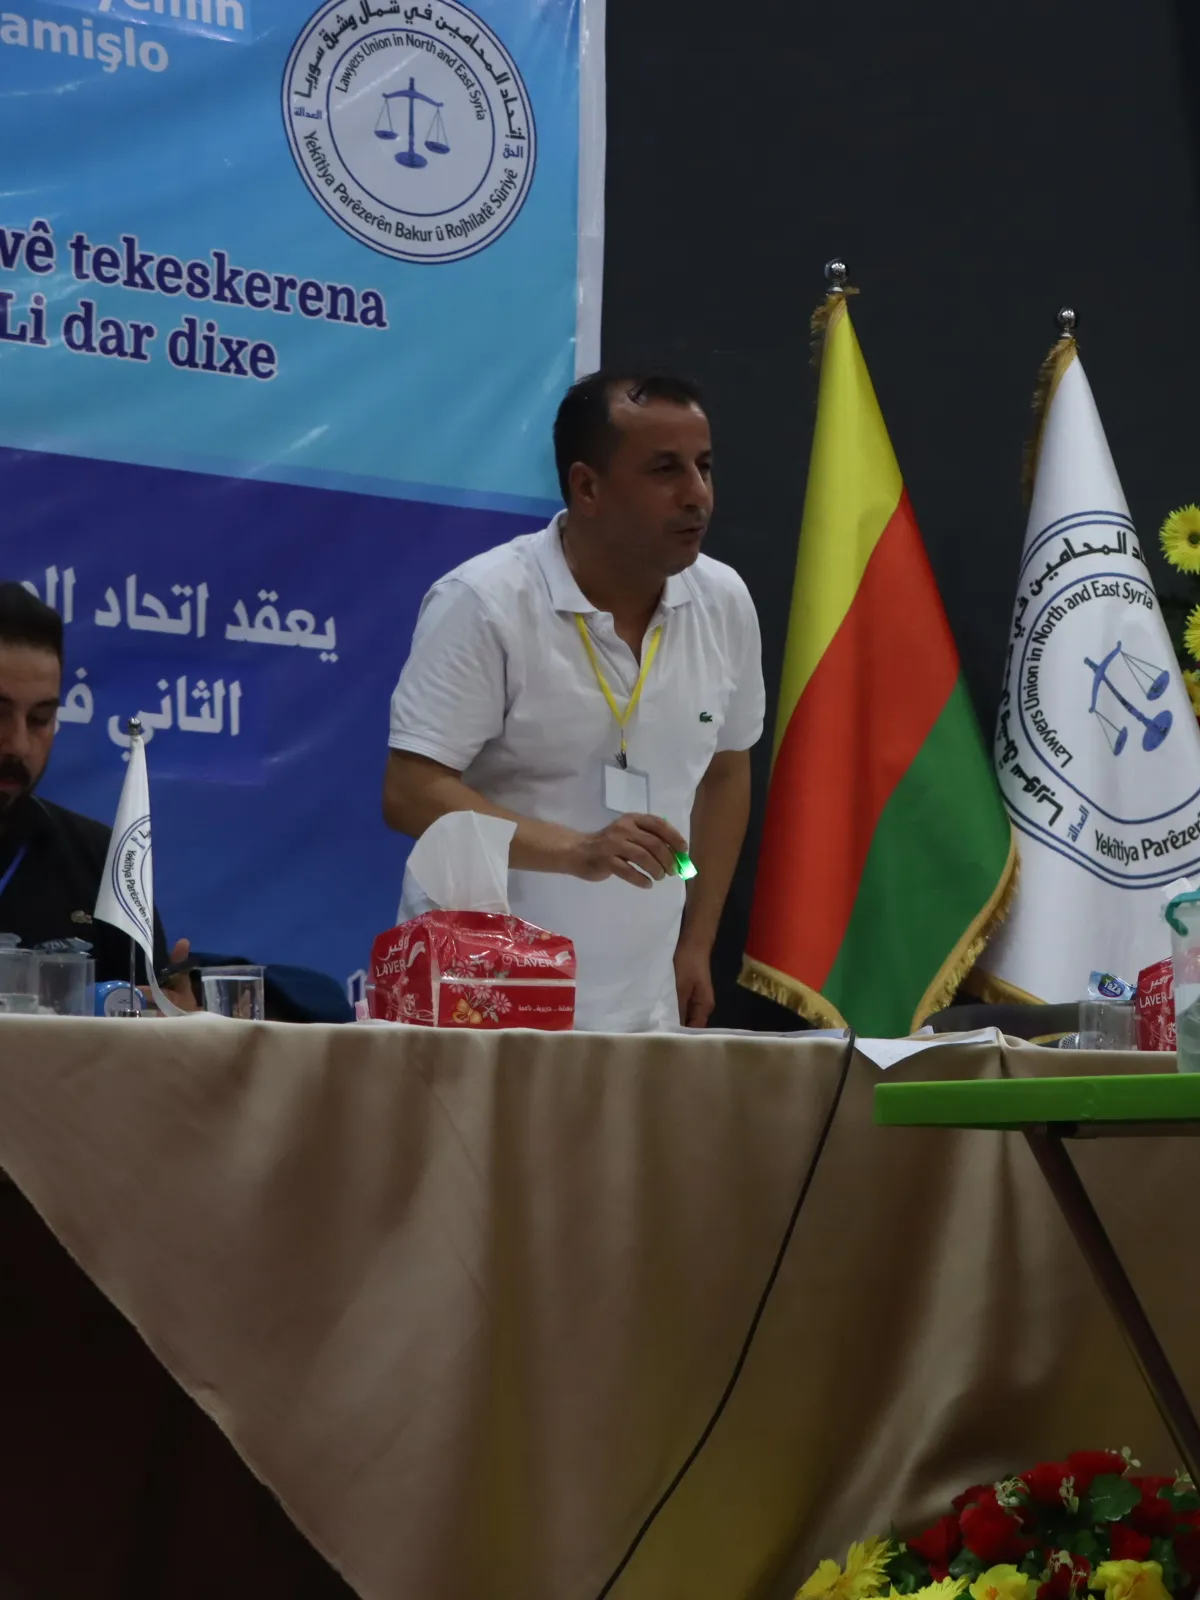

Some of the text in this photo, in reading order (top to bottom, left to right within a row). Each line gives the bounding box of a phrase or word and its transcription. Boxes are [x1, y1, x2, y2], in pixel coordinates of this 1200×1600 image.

[319, 14, 358, 50] وشرق
[359, 0, 400, 25] شمال
[404, 4, 432, 25] في
[0, 13, 169, 72] amişlo
[435, 16, 511, 85] المحامين
[294, 46, 325, 98] سوريا
[335, 33, 487, 121] Lawyers Union in North and East Syria
[303, 130, 518, 242] Yekîtiya Parêzerên Bakur û Rojhilatê Sûriyê
[70, 233, 387, 328] tekeskerena
[63, 300, 155, 360] dar
[168, 317, 277, 379] dixe
[1029, 530, 1127, 596] المحامين
[95, 574, 209, 638] اتحاد
[1064, 584, 1091, 610] and
[1091, 580, 1120, 598] East
[1122, 582, 1153, 610] Syria
[225, 589, 339, 662] يعقد
[1032, 605, 1068, 645] North
[1026, 647, 1043, 662] in
[1023, 665, 1041, 711] Union
[55, 667, 242, 762] الثاني ف
[1031, 709, 1073, 768] Lawyers
[1010, 763, 1063, 827] سوريا
[1095, 829, 1139, 866] Yekîtiya
[376, 959, 407, 977] LAVER
[515, 955, 554, 968] LAVER
[1140, 992, 1168, 1008] LAVER
